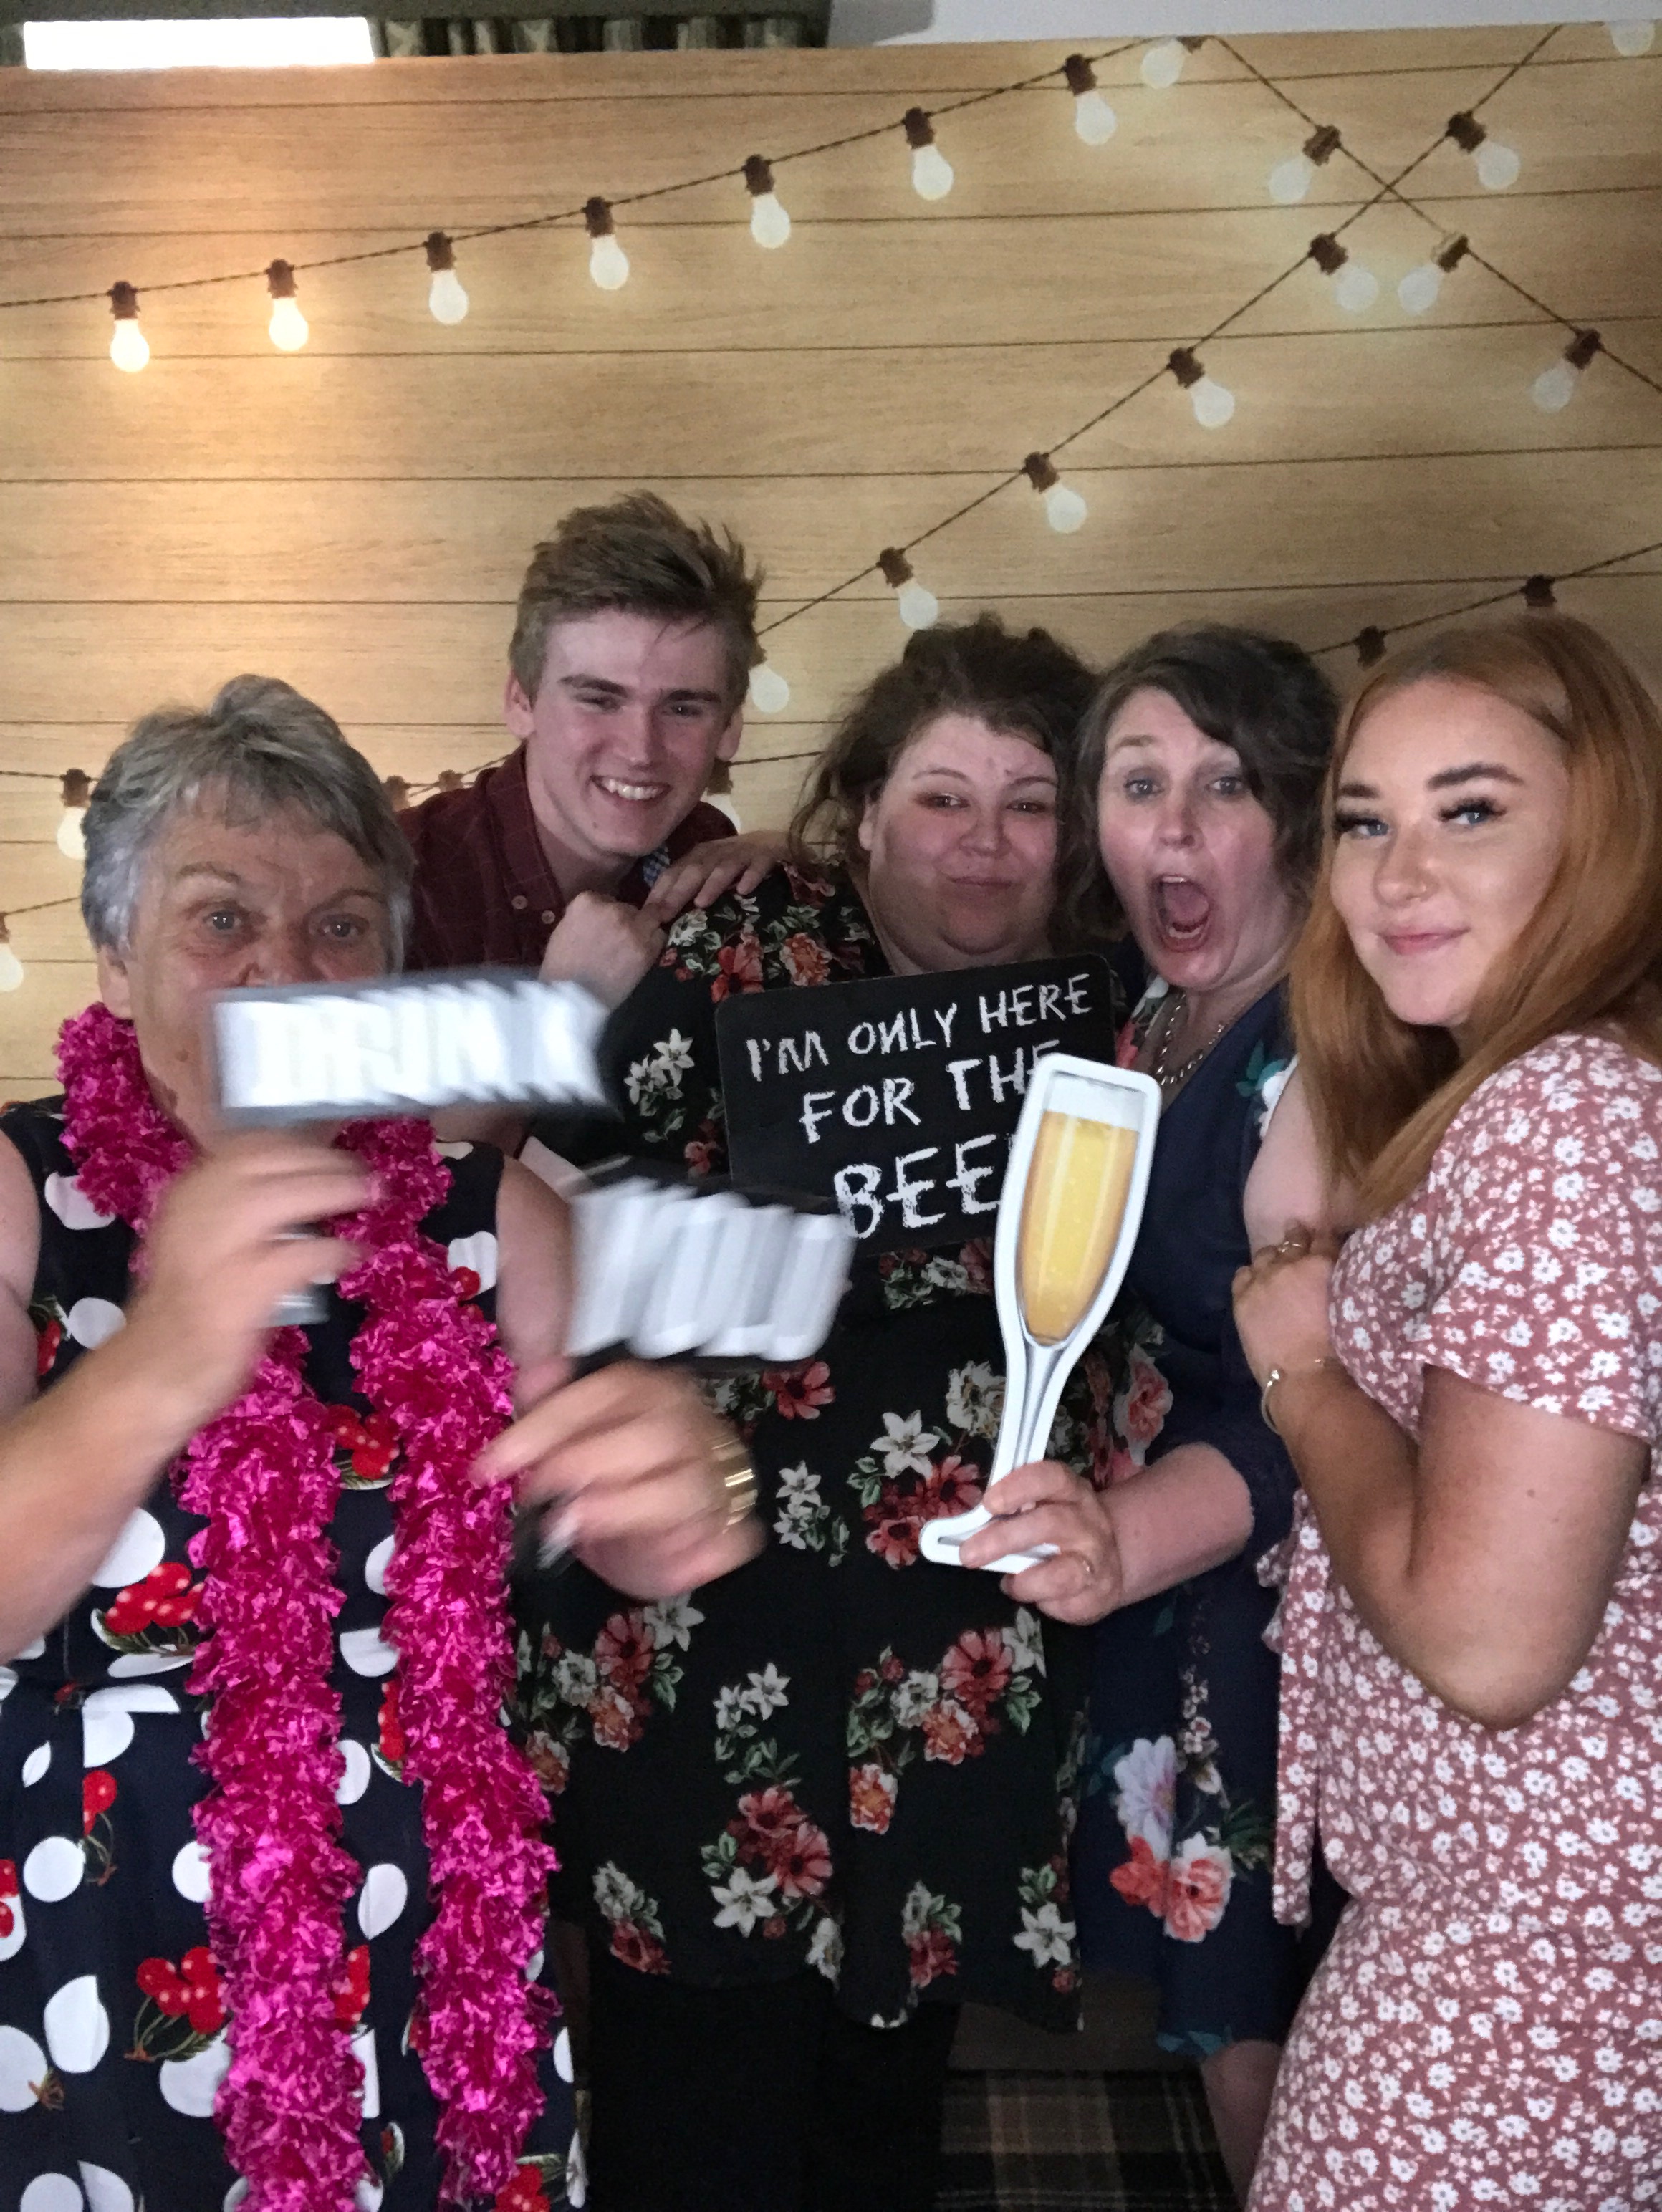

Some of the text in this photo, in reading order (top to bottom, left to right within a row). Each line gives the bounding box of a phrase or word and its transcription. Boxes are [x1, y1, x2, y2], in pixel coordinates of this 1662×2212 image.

[746, 973, 1090, 1082] I'M ONLY HERE
[799, 1077, 921, 1145] FOR
[833, 1134, 1014, 1240] BEE
